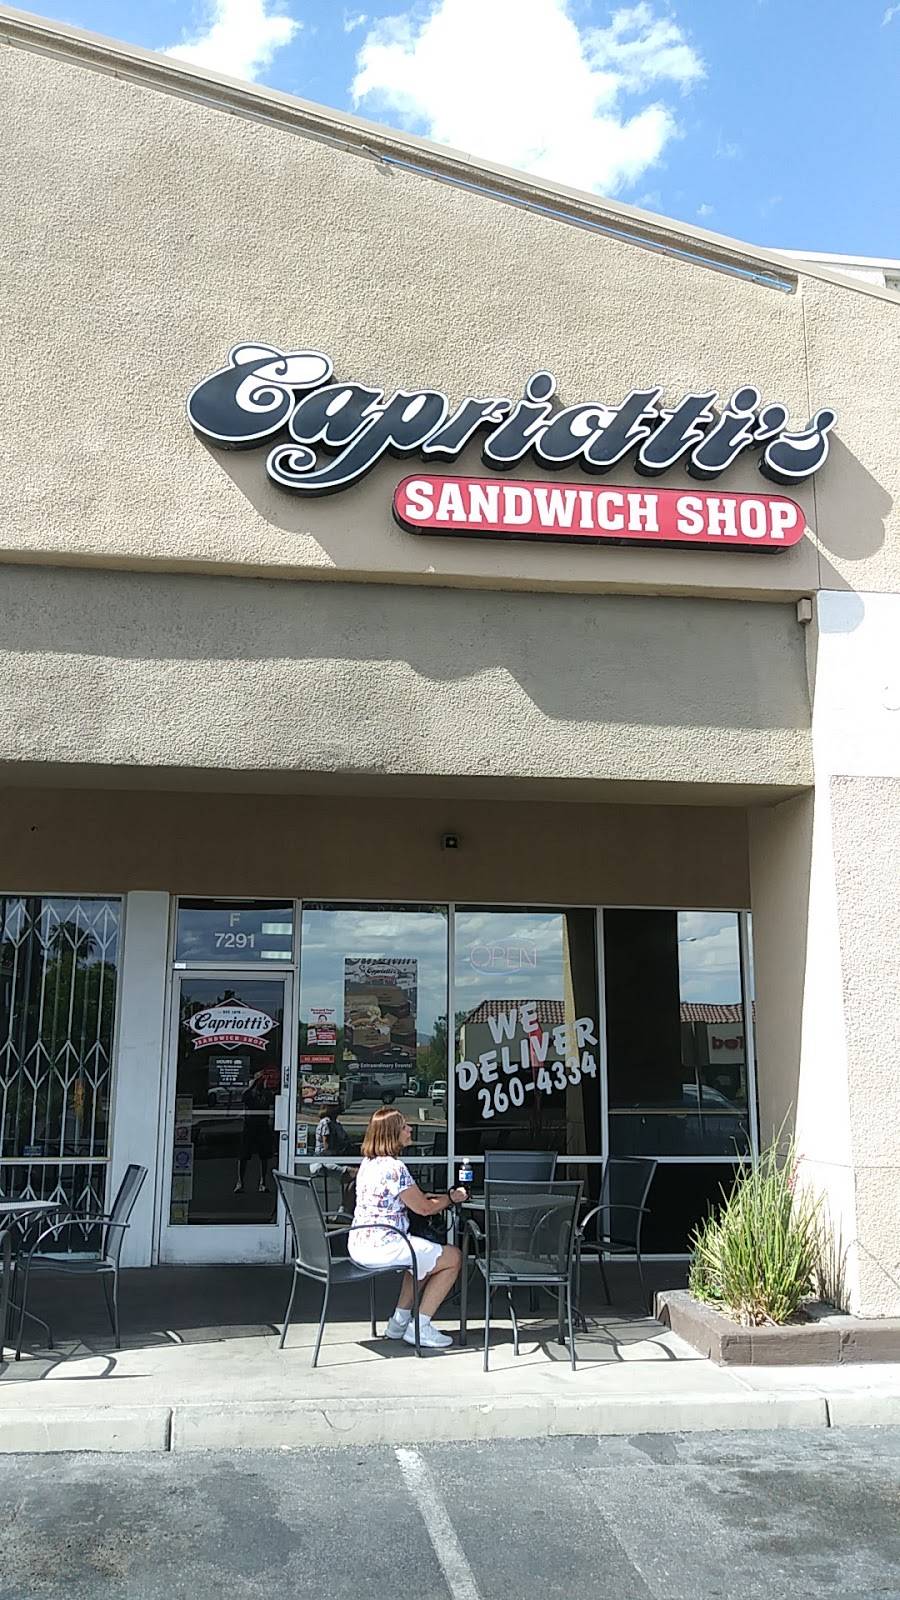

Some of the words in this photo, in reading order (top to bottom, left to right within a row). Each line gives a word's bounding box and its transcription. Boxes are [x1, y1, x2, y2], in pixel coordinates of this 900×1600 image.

[186, 341, 838, 492] Capriotti's
[404, 480, 660, 533] SANDWICH
[676, 494, 799, 540] SHOP
[229, 912, 240, 927] F
[214, 931, 255, 948] 7291
[470, 946, 537, 969] OPEN
[194, 1012, 271, 1033] Capriotti's
[487, 1001, 539, 1044] WE
[197, 1035, 240, 1045] SANDWICH
[243, 1036, 264, 1045] SHOP
[455, 1017, 599, 1091] DELIVER
[477, 1051, 597, 1119] 260-4334
